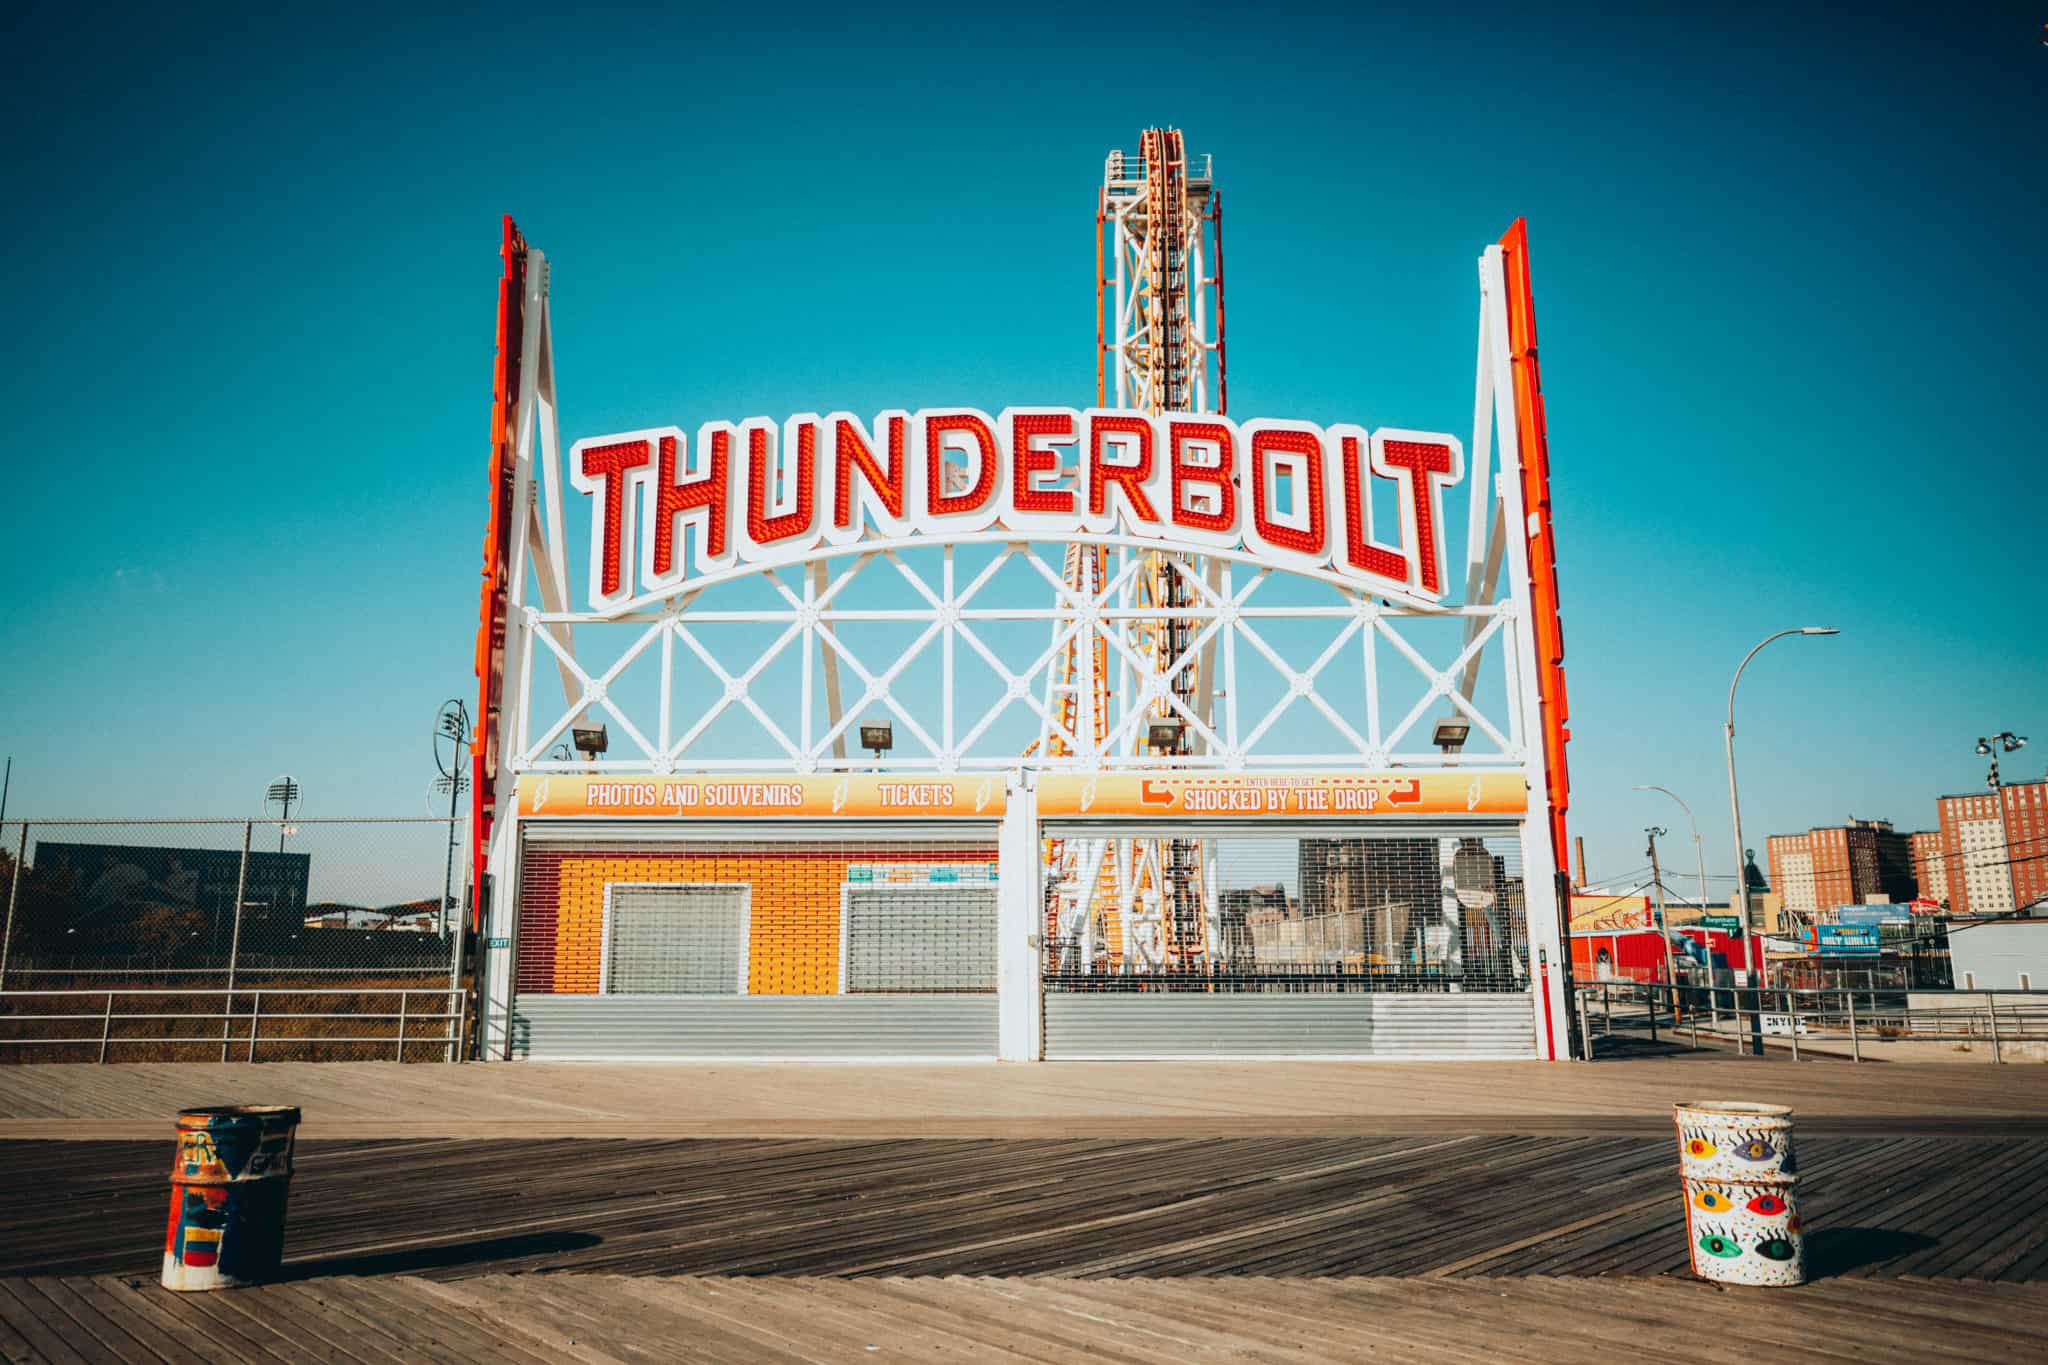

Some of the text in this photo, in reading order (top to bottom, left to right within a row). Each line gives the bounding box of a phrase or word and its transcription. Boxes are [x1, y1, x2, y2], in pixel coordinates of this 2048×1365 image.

[578, 411, 1458, 602] THUNDERBOLT
[587, 784, 803, 806] PHOTOS AND SOUVENIRS
[878, 784, 953, 806] TICKETS
[1184, 788, 1379, 810] SHOCKED BY THE DROP
